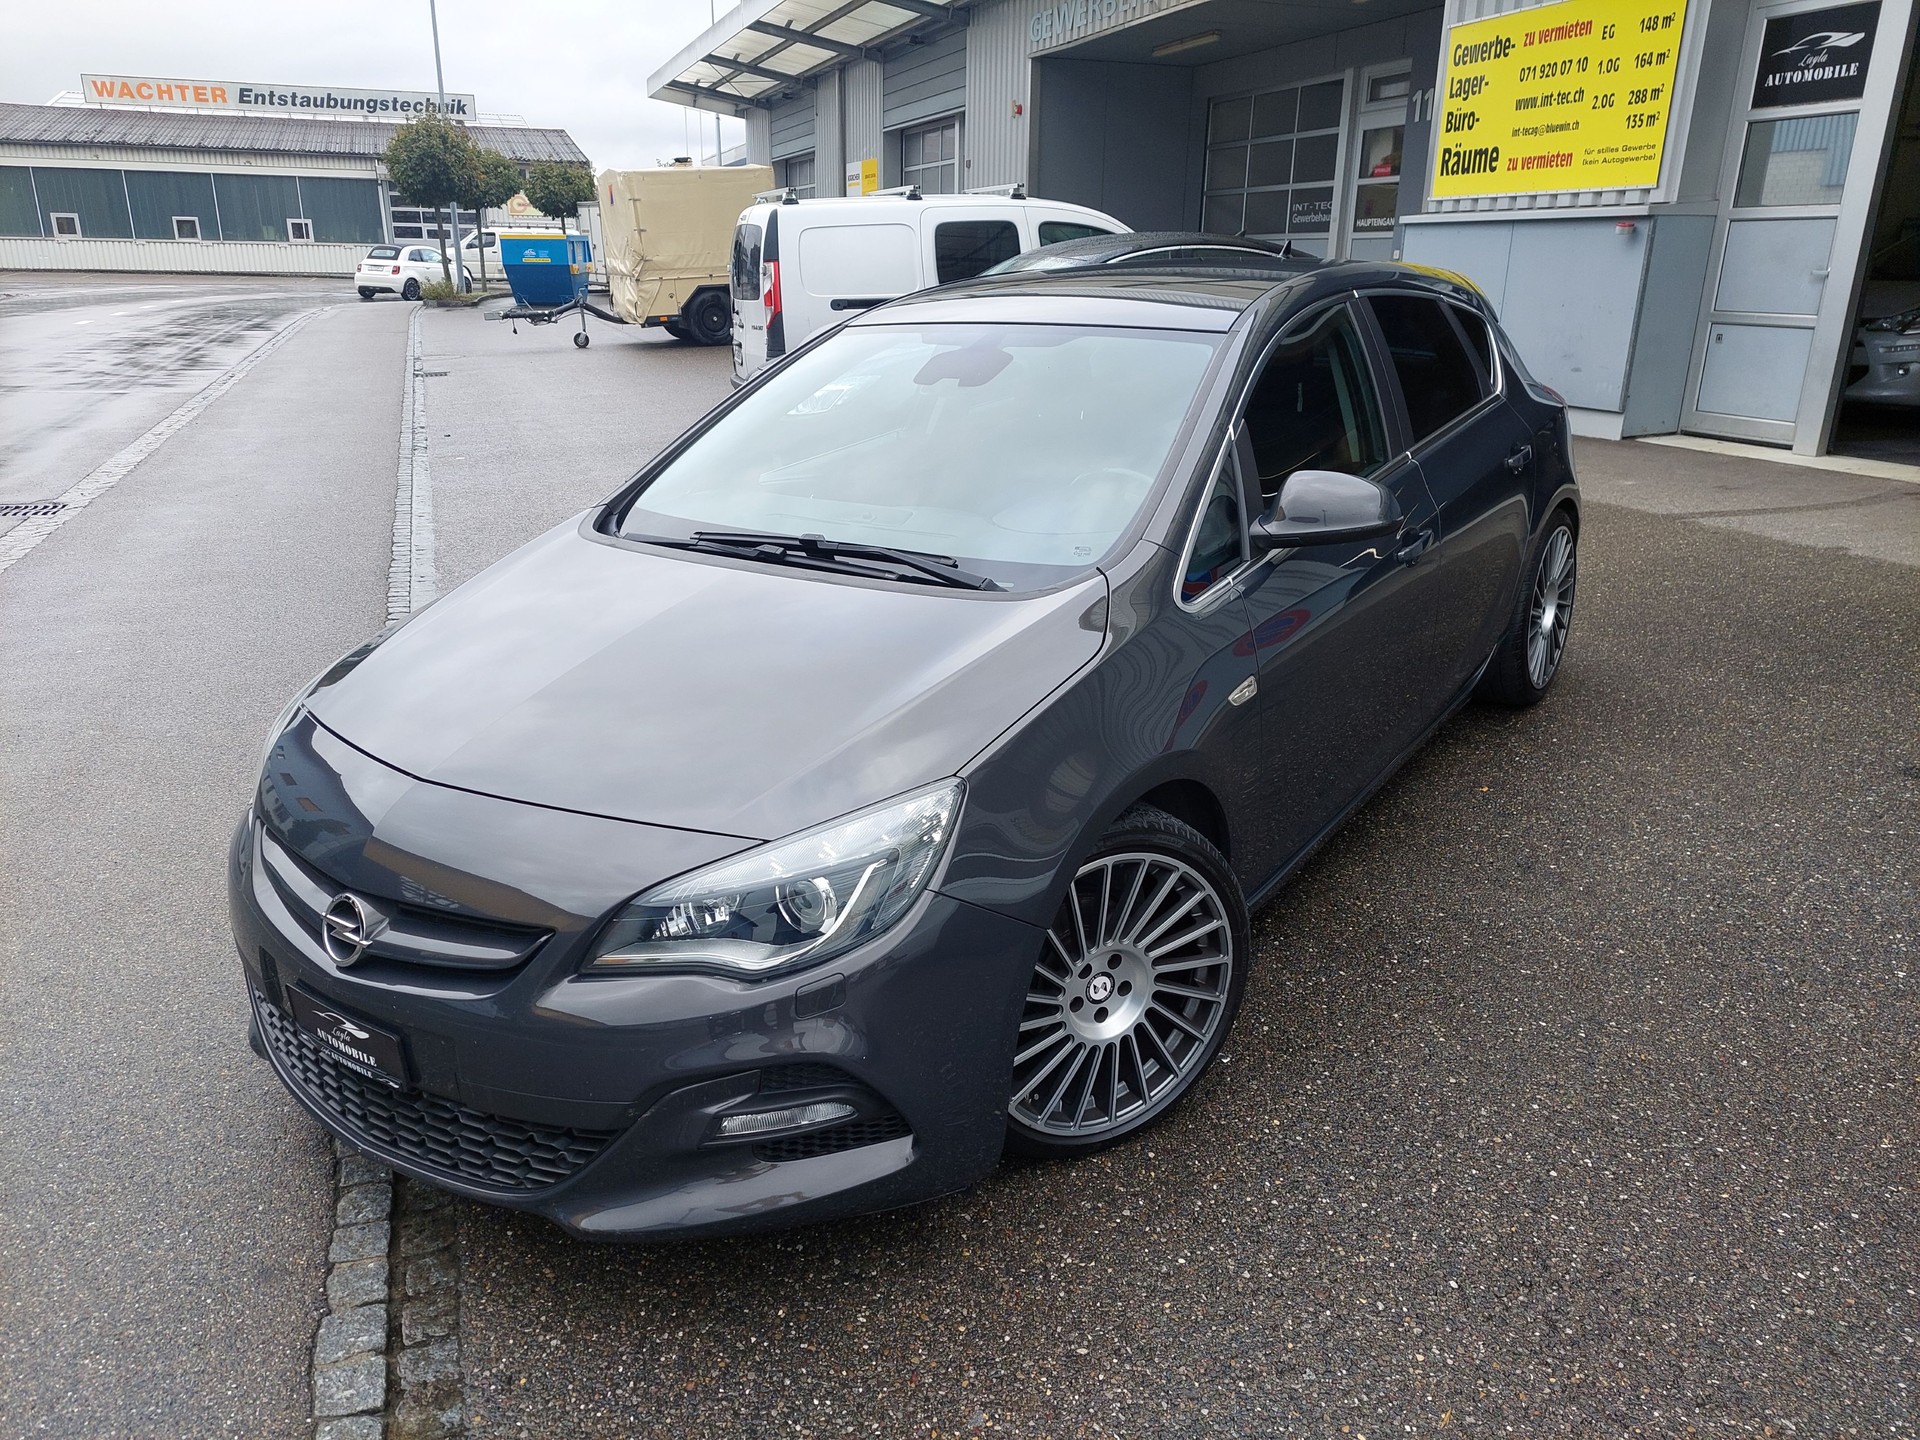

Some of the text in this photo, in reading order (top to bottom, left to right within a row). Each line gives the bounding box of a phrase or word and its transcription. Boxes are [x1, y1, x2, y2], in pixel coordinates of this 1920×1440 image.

[1030, 0, 1160, 42] GEWERB
[1523, 19, 1593, 47] zu vermieten
[1602, 23, 1616, 41] EG
[1639, 11, 1677, 33] 148 m²
[1453, 35, 1516, 67] Gewerbe-
[1634, 48, 1671, 69] 164 m²
[1798, 48, 1829, 69] Layla
[1519, 56, 1589, 83] 071 920 07 10
[1764, 62, 1860, 87] AUTOMOBILE
[91, 79, 228, 104] WACHTER
[1449, 73, 1490, 101] Lager-
[1515, 86, 1585, 111] www.int-tec.ch
[1627, 83, 1665, 106] 288 m²
[238, 87, 468, 115] Entstaubungstechnik
[1412, 87, 1435, 123] 11
[1445, 109, 1481, 133] Büro-
[1511, 119, 1580, 138] int-tecag@bluewin.ch
[1625, 111, 1661, 130] 135 m²
[1440, 142, 1500, 177] Räume
[1506, 150, 1574, 172] zu vermieten
[1582, 152, 1657, 166] (kein Autogewerbe)
[1584, 142, 1657, 155] für stilles Gewerbe
[1356, 217, 1395, 227] HAUPTEINGAN
[317, 1027, 378, 1067] AUTOMOBILE
[331, 1051, 374, 1079] AUTOMOBILE
